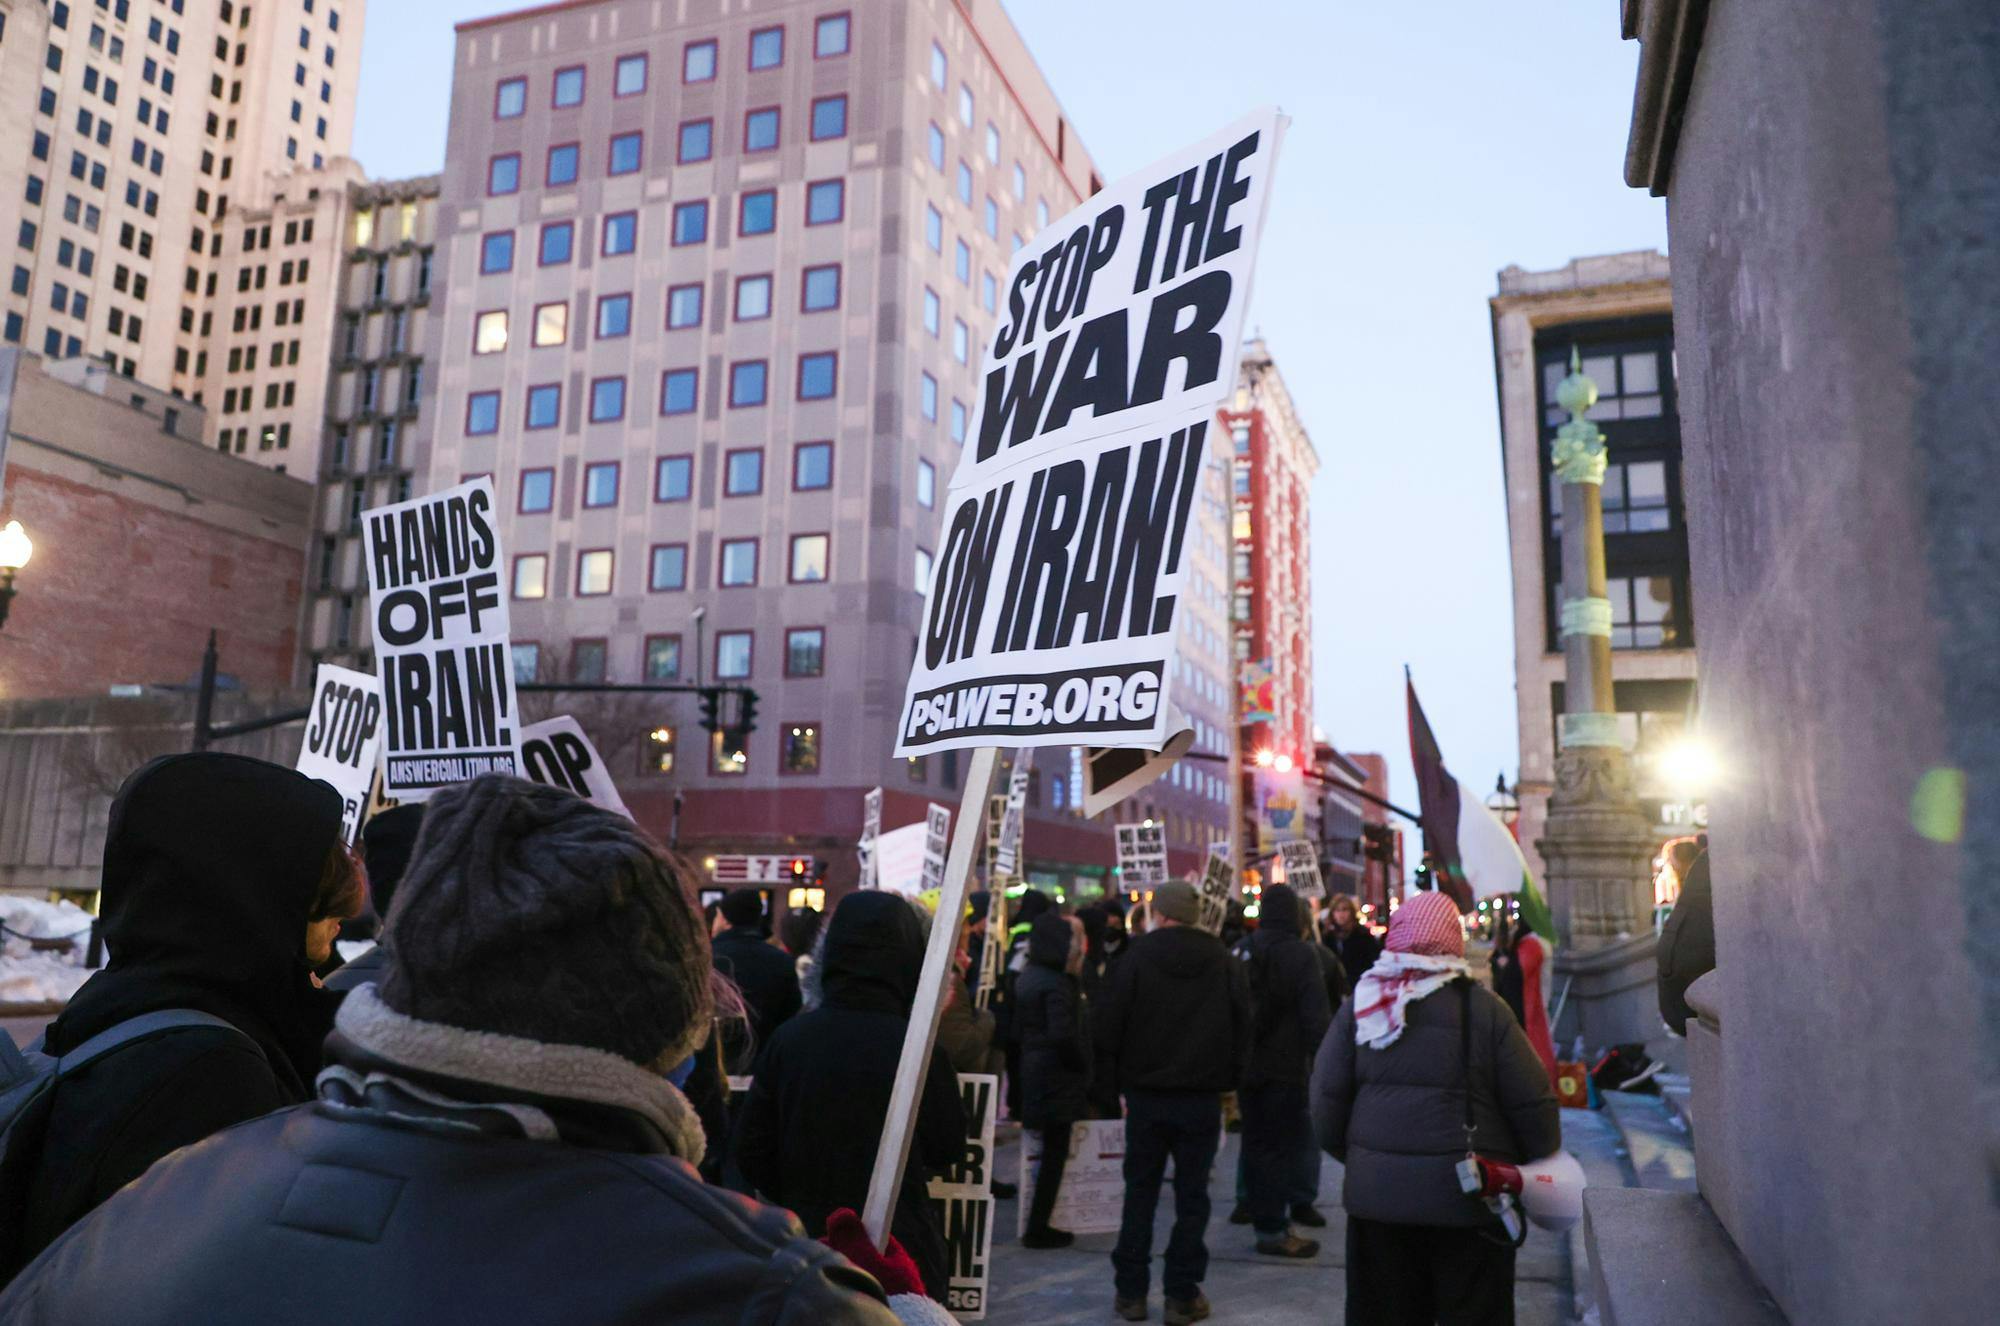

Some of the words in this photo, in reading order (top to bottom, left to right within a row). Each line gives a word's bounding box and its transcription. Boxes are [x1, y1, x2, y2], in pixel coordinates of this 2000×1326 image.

[994, 204, 1125, 360] STOP
[1132, 130, 1261, 295] THE
[977, 270, 1233, 464] WAR
[371, 489, 495, 590] HANDS
[926, 481, 1015, 671] ON
[991, 420, 1210, 654] IRAN!
[378, 572, 498, 646] OFF
[310, 680, 380, 769] STOP
[384, 643, 512, 751] IRAN!
[907, 671, 1159, 738] PSLWEB.ORG
[522, 731, 592, 798] OP
[756, 859, 771, 879] 7
